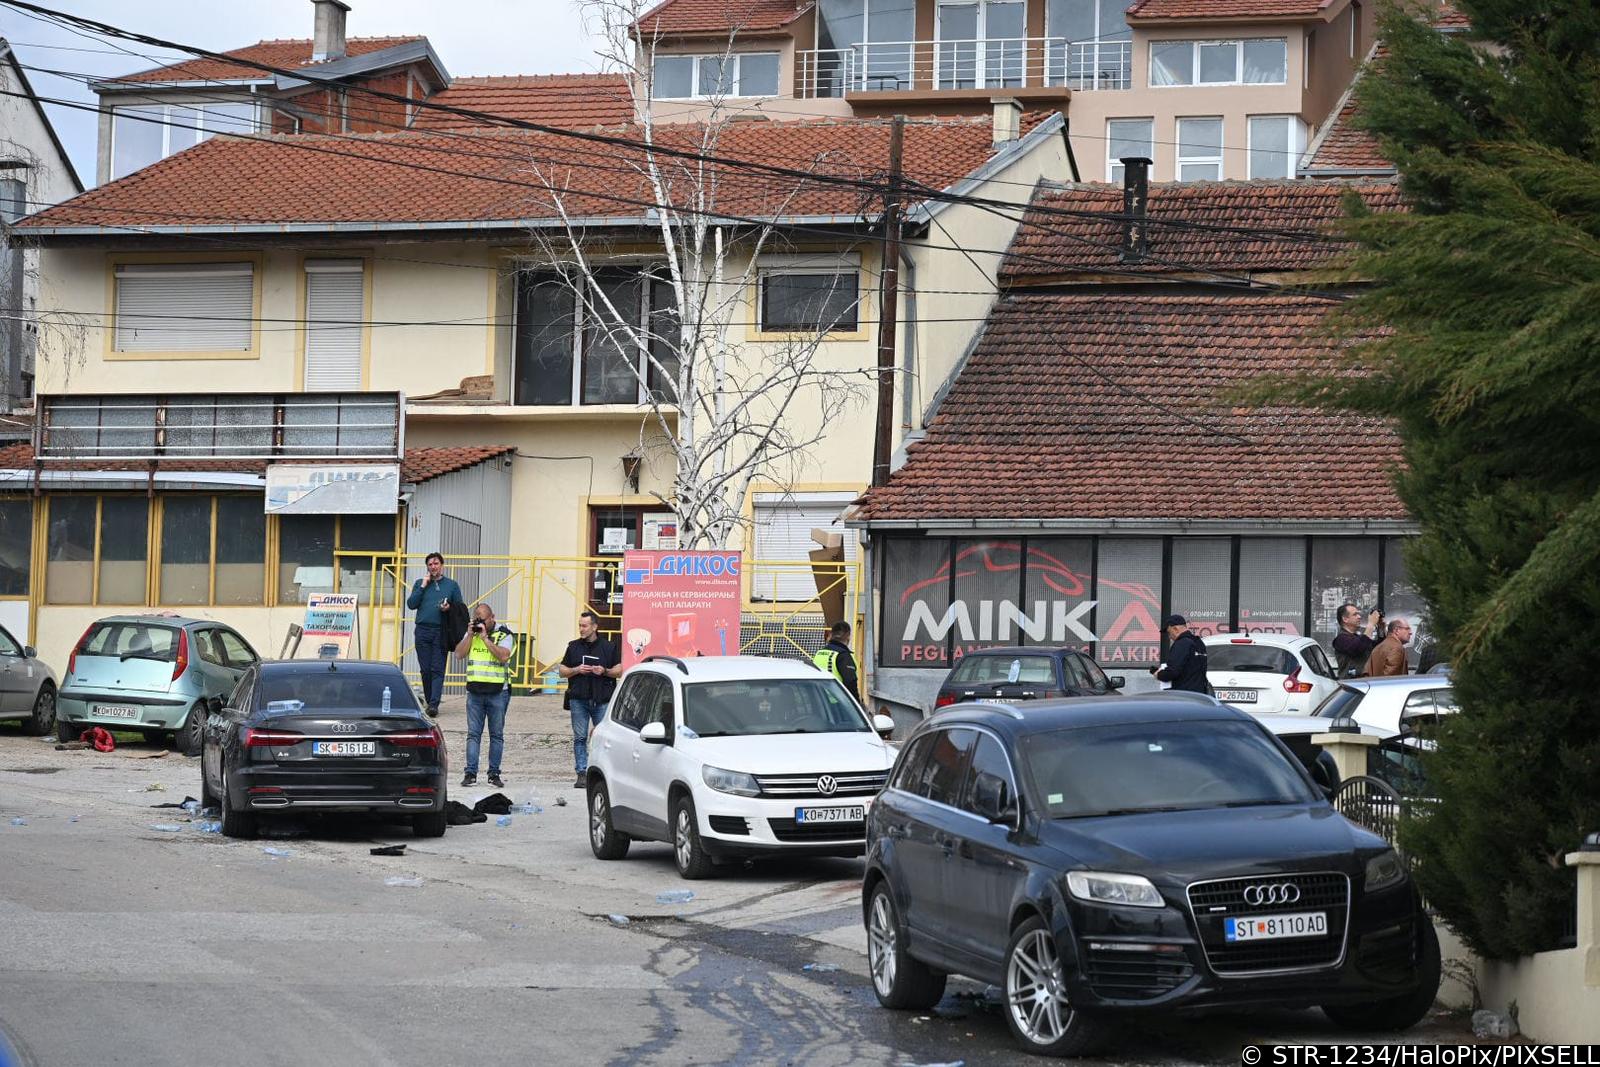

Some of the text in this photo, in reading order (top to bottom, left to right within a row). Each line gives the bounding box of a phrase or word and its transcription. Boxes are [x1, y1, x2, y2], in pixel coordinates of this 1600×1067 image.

[654, 555, 739, 576] ДИКОС
[323, 596, 355, 604] ДИКОС
[628, 591, 671, 600] ПРОДАЖБА
[902, 600, 1161, 641] MINKA
[1101, 646, 1160, 661] LAKIR
[319, 742, 375, 754] SK 5161 BJ
[804, 808, 862, 822] KO 7371 AB
[1237, 915, 1325, 937] ST 8110 AD
